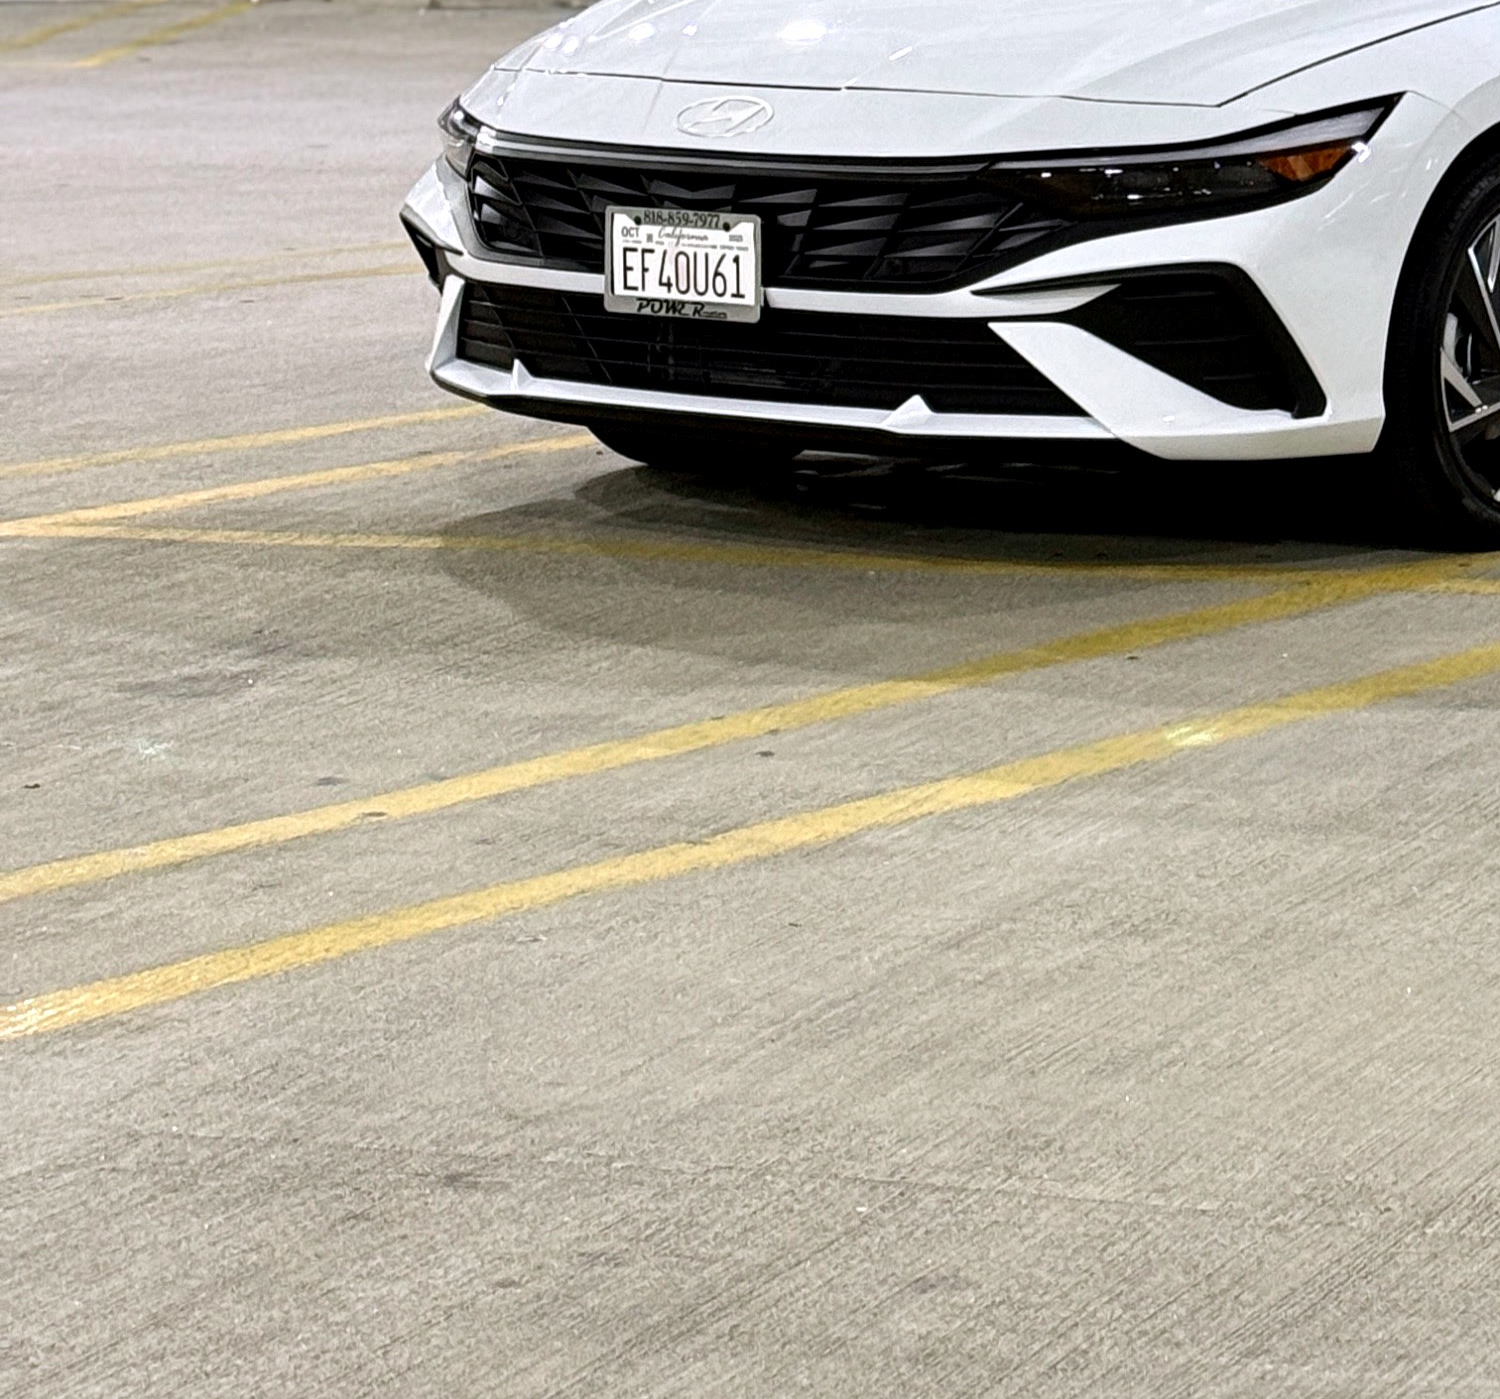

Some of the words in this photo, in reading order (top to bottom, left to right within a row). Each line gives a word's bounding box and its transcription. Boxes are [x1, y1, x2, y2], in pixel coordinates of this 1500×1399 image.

[643, 211, 720, 228] 818-859-7977
[621, 226, 639, 238] OCT
[658, 226, 709, 246] California
[623, 247, 745, 298] EF40U61
[636, 299, 706, 317] POWER
